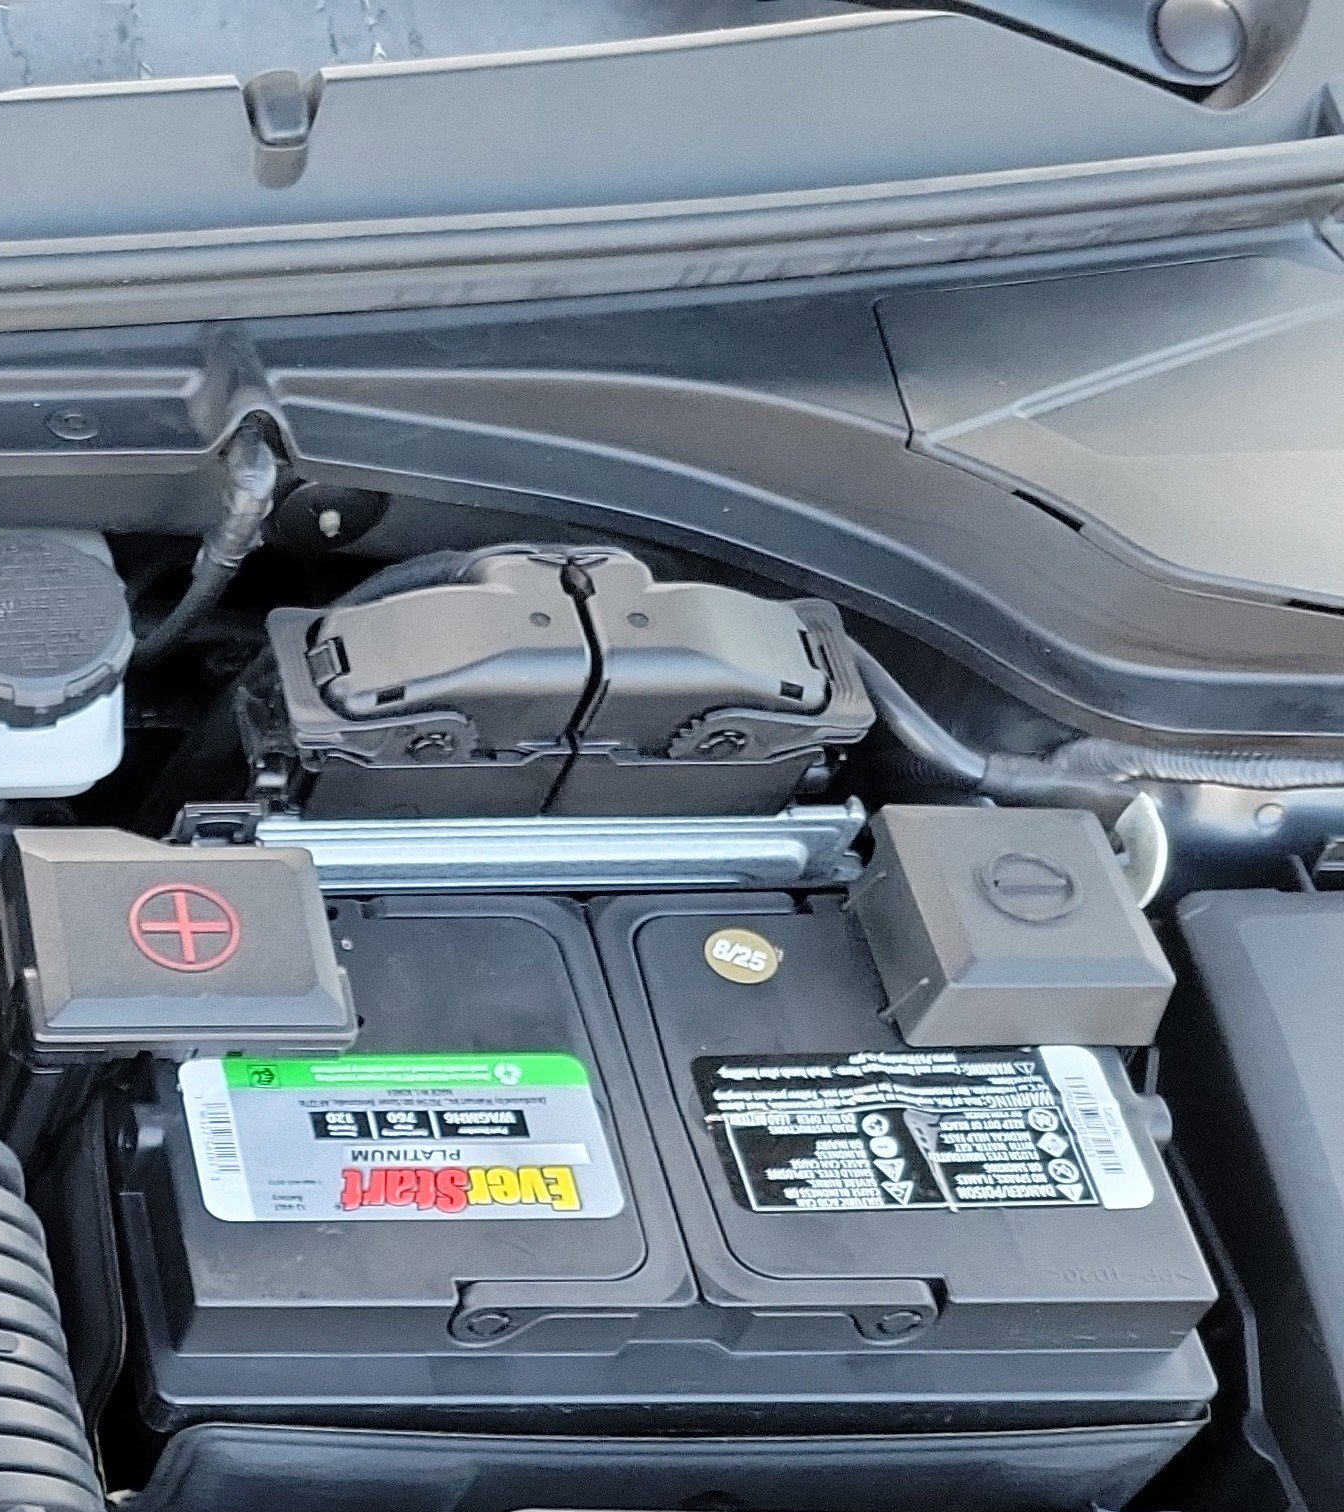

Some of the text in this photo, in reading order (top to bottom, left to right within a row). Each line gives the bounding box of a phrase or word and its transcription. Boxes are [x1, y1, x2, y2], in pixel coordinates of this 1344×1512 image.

[712, 938, 768, 972] 8/25
[386, 1112, 418, 1124] 760
[352, 1149, 461, 1162] PLATINUM
[341, 1165, 582, 1213] EverStart
[955, 1184, 1057, 1199] DANGER/POISON
